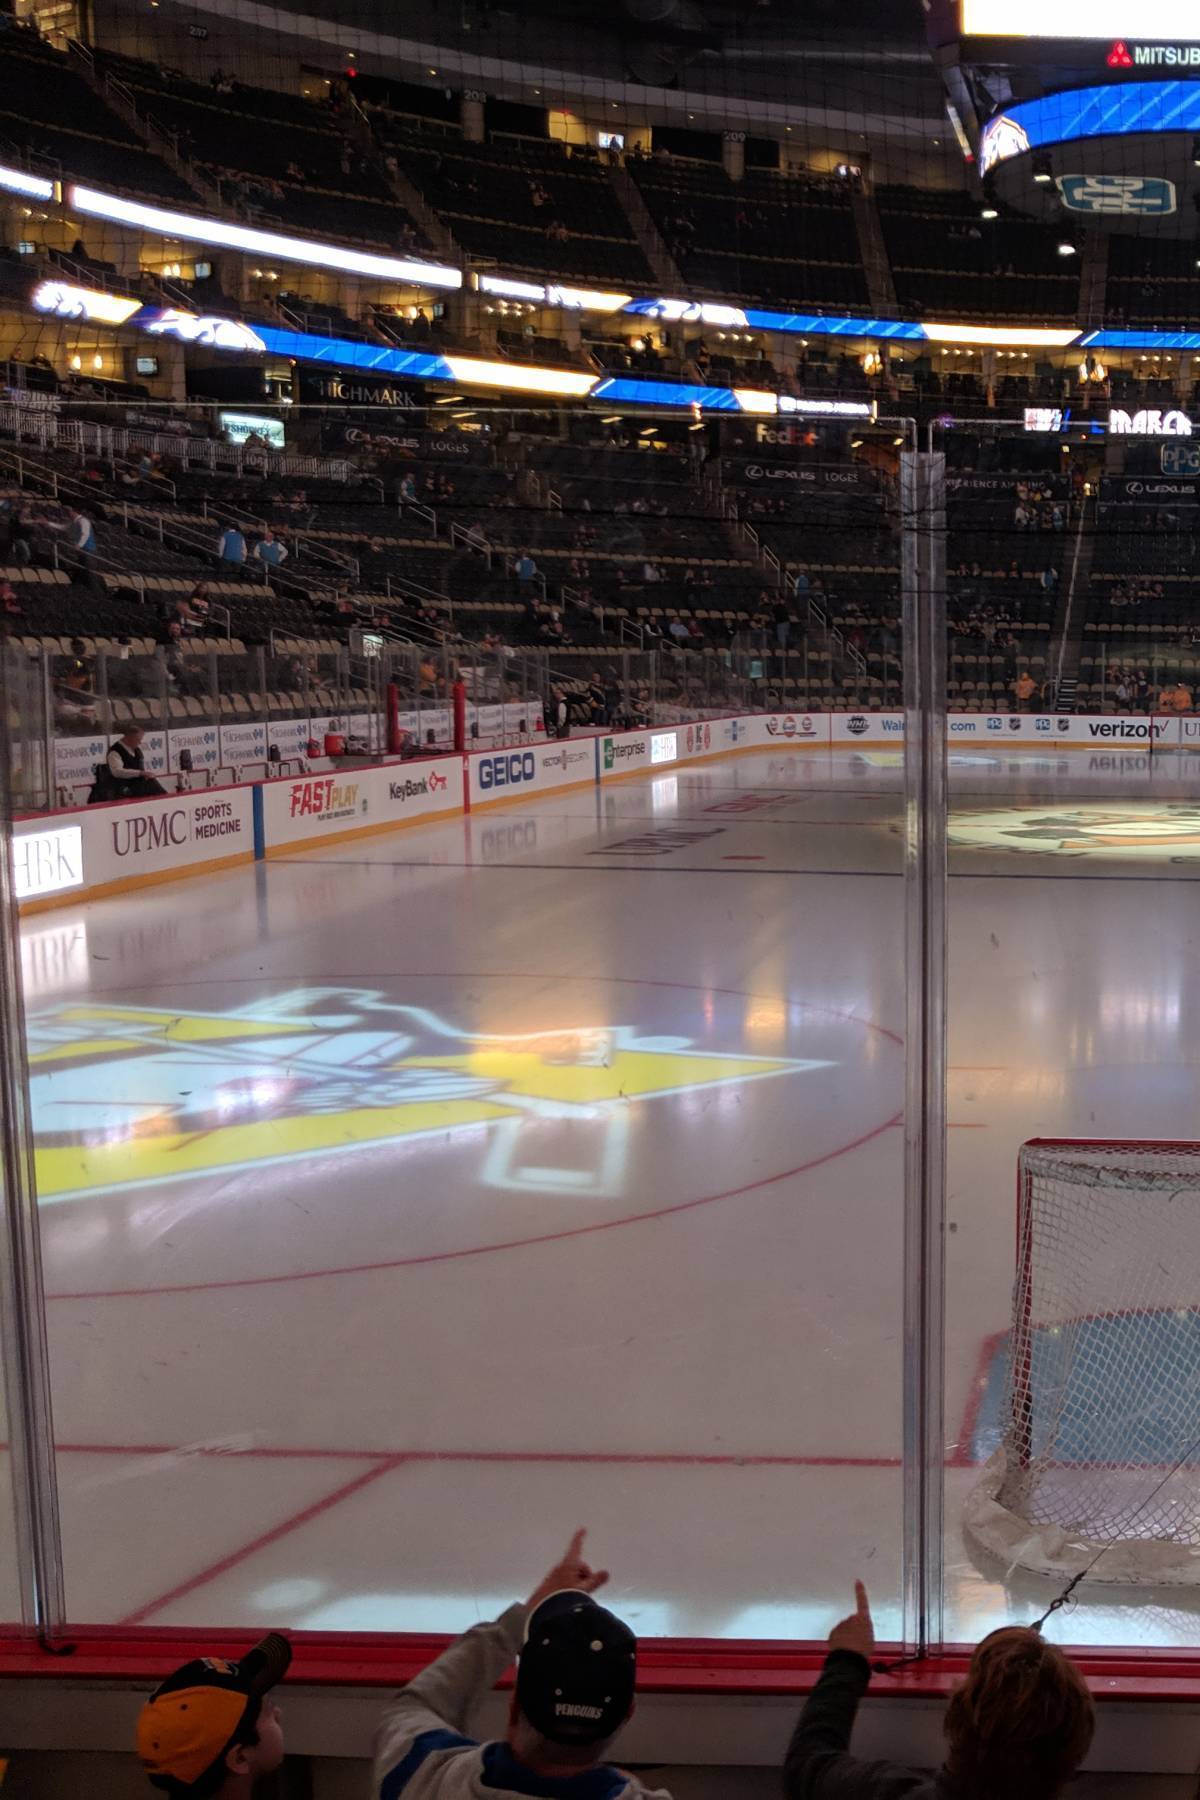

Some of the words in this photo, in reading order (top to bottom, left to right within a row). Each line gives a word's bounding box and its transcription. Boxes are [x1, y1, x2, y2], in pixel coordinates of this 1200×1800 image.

[318, 380, 417, 407] HIGHMARK
[365, 433, 420, 449] LEXUS
[431, 440, 470, 454] LOGES
[765, 469, 816, 481] LEXUS
[825, 472, 859, 483] LOGES
[1146, 484, 1195, 494] LEXUS
[1089, 720, 1160, 738] verizon
[604, 739, 646, 761] enterprise
[479, 751, 535, 789] GEICO
[542, 756, 562, 769] VECTOR
[389, 777, 429, 802] KeyBank
[194, 802, 233, 822] SPORTS
[111, 810, 187, 856] UPMC
[195, 819, 241, 841] MEDICINE
